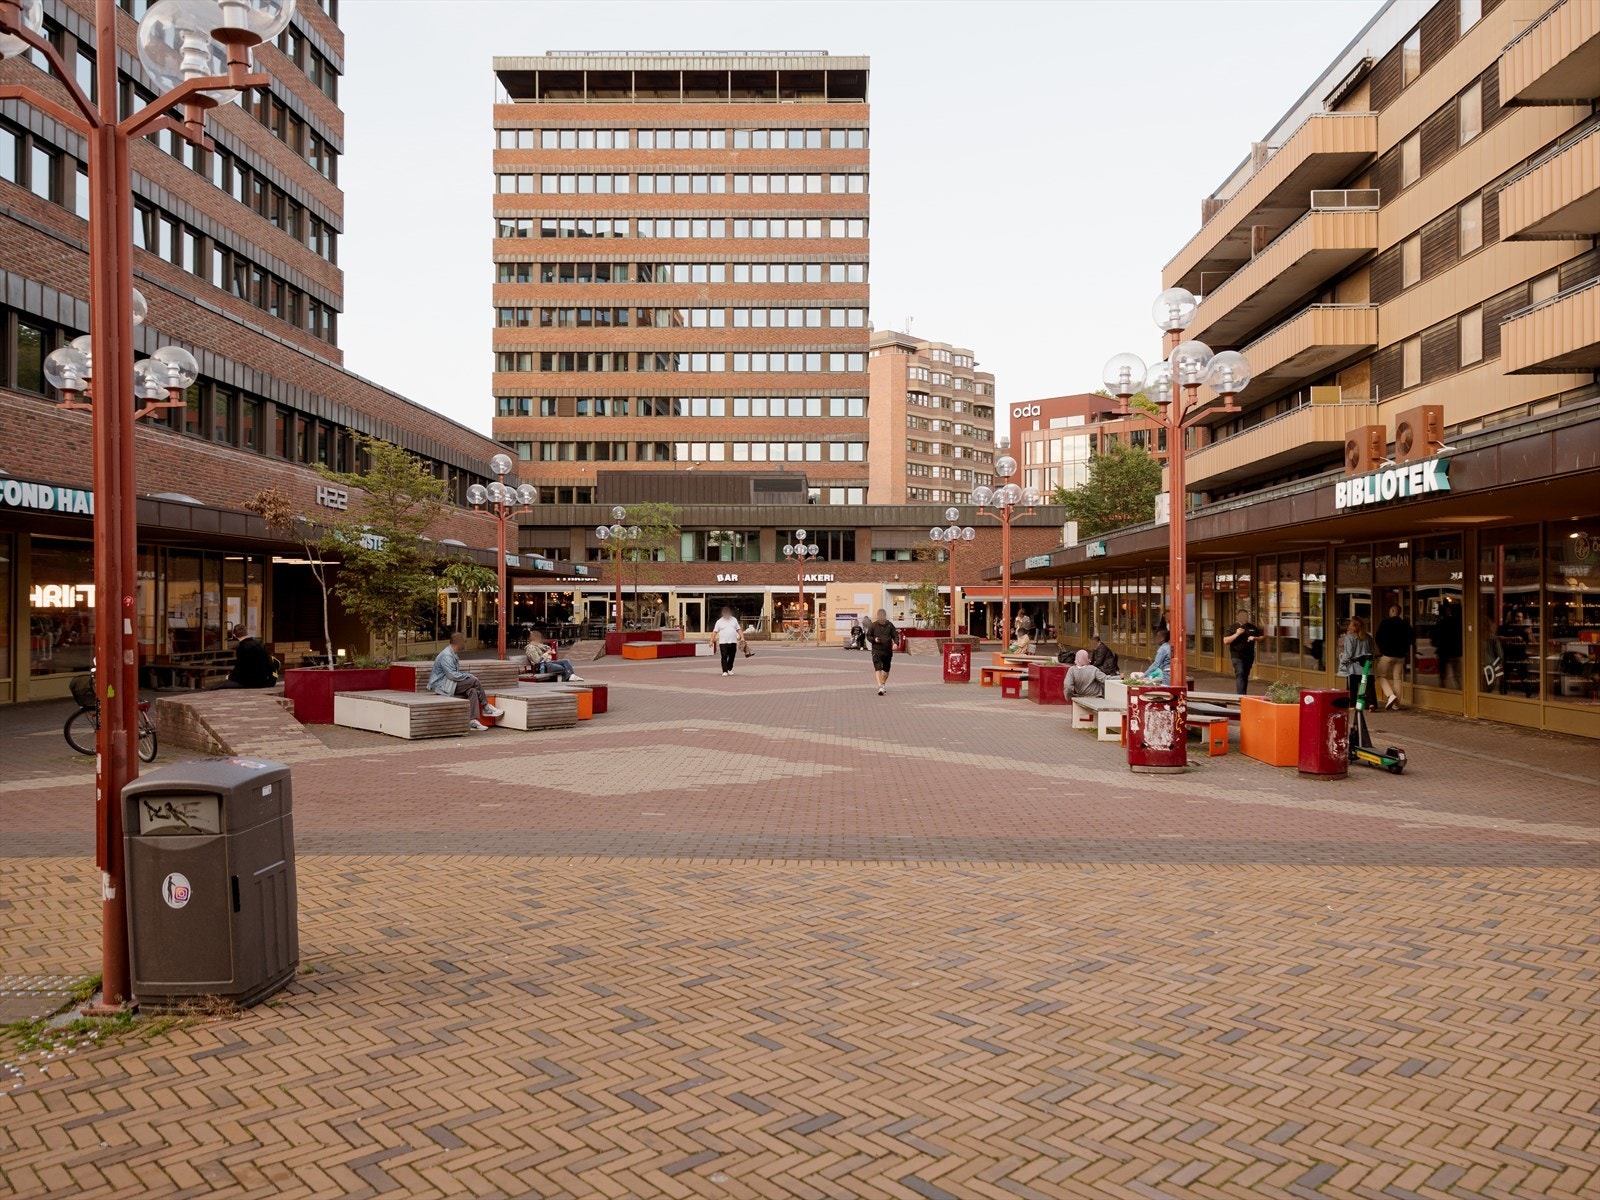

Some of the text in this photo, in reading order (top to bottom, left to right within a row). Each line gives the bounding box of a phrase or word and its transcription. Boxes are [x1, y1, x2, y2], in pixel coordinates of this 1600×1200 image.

[1013, 403, 1041, 419] oda
[1335, 459, 1440, 509] BIBLIOTEK
[0, 479, 94, 515] OND HA
[316, 485, 348, 510] H22
[1375, 553, 1409, 569] DEICHMAN
[716, 573, 738, 583] BAR
